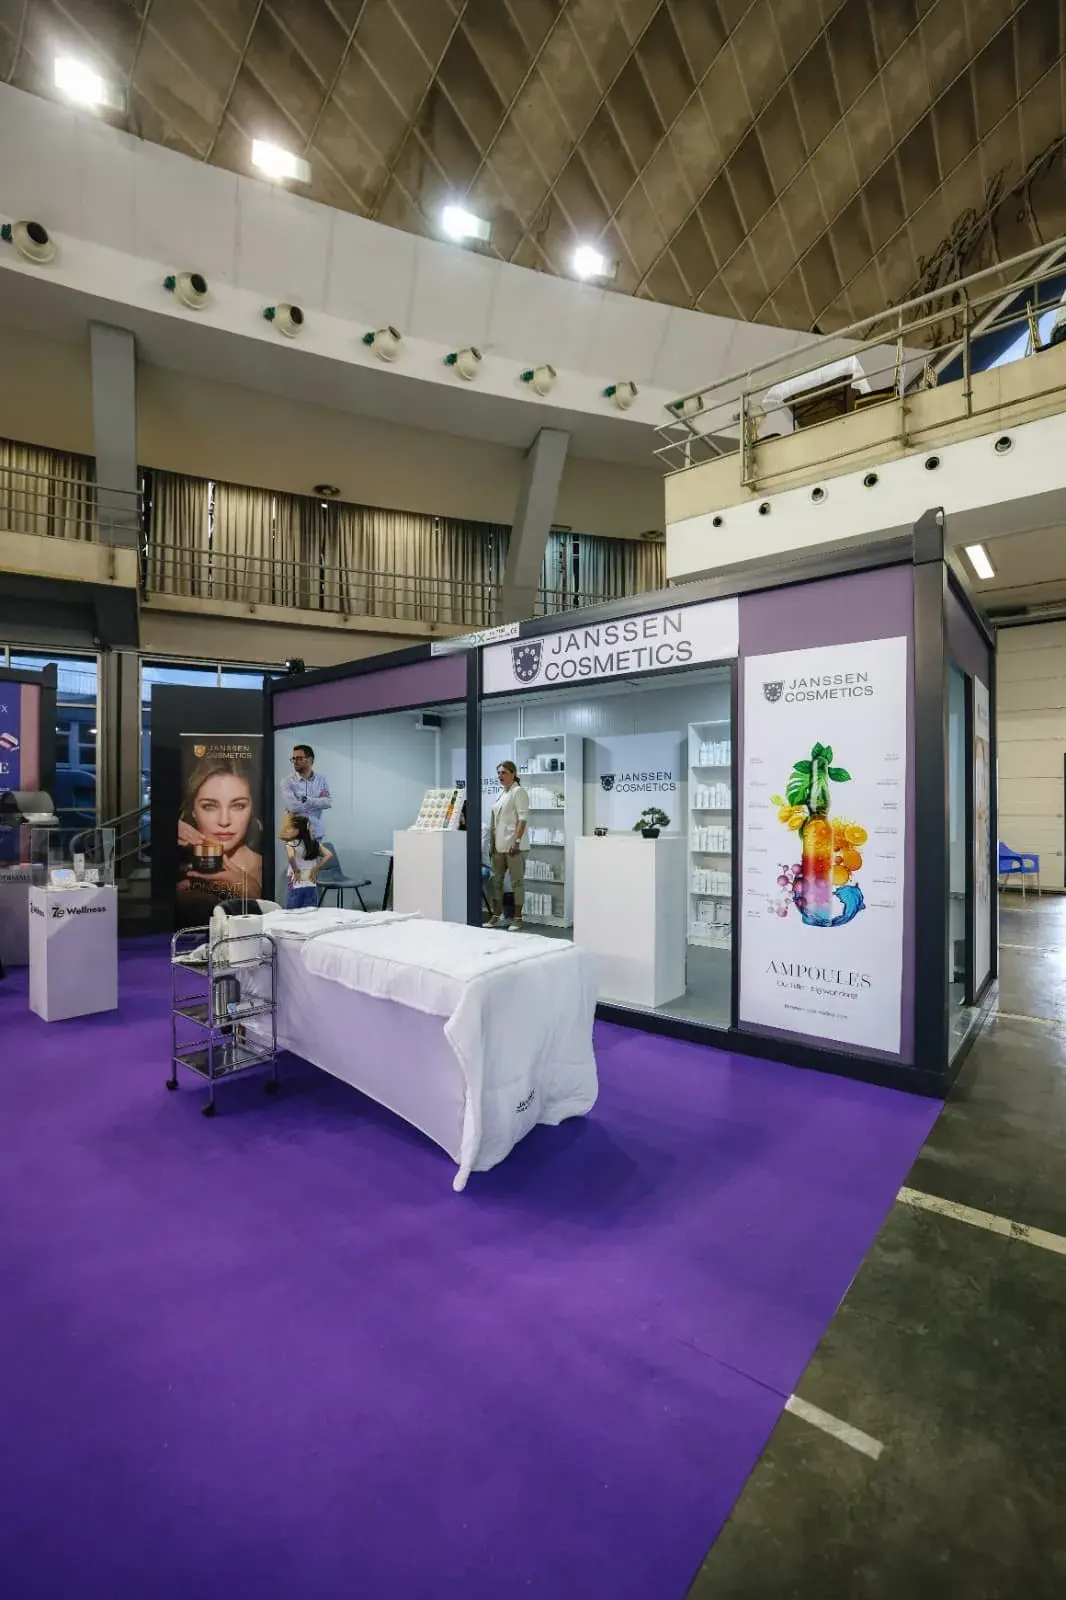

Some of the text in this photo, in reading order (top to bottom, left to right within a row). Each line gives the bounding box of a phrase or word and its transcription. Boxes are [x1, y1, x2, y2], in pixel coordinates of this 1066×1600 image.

[551, 612, 683, 655] JANSSEN
[544, 640, 694, 682] COSMETICS
[788, 672, 869, 690] JANSSEN
[784, 685, 874, 703] COSMETICS
[618, 771, 672, 782] JANSSEN
[615, 781, 677, 793] COSMETICS
[66, 905, 107, 915] Wellness
[765, 960, 872, 989] AMPOULES
